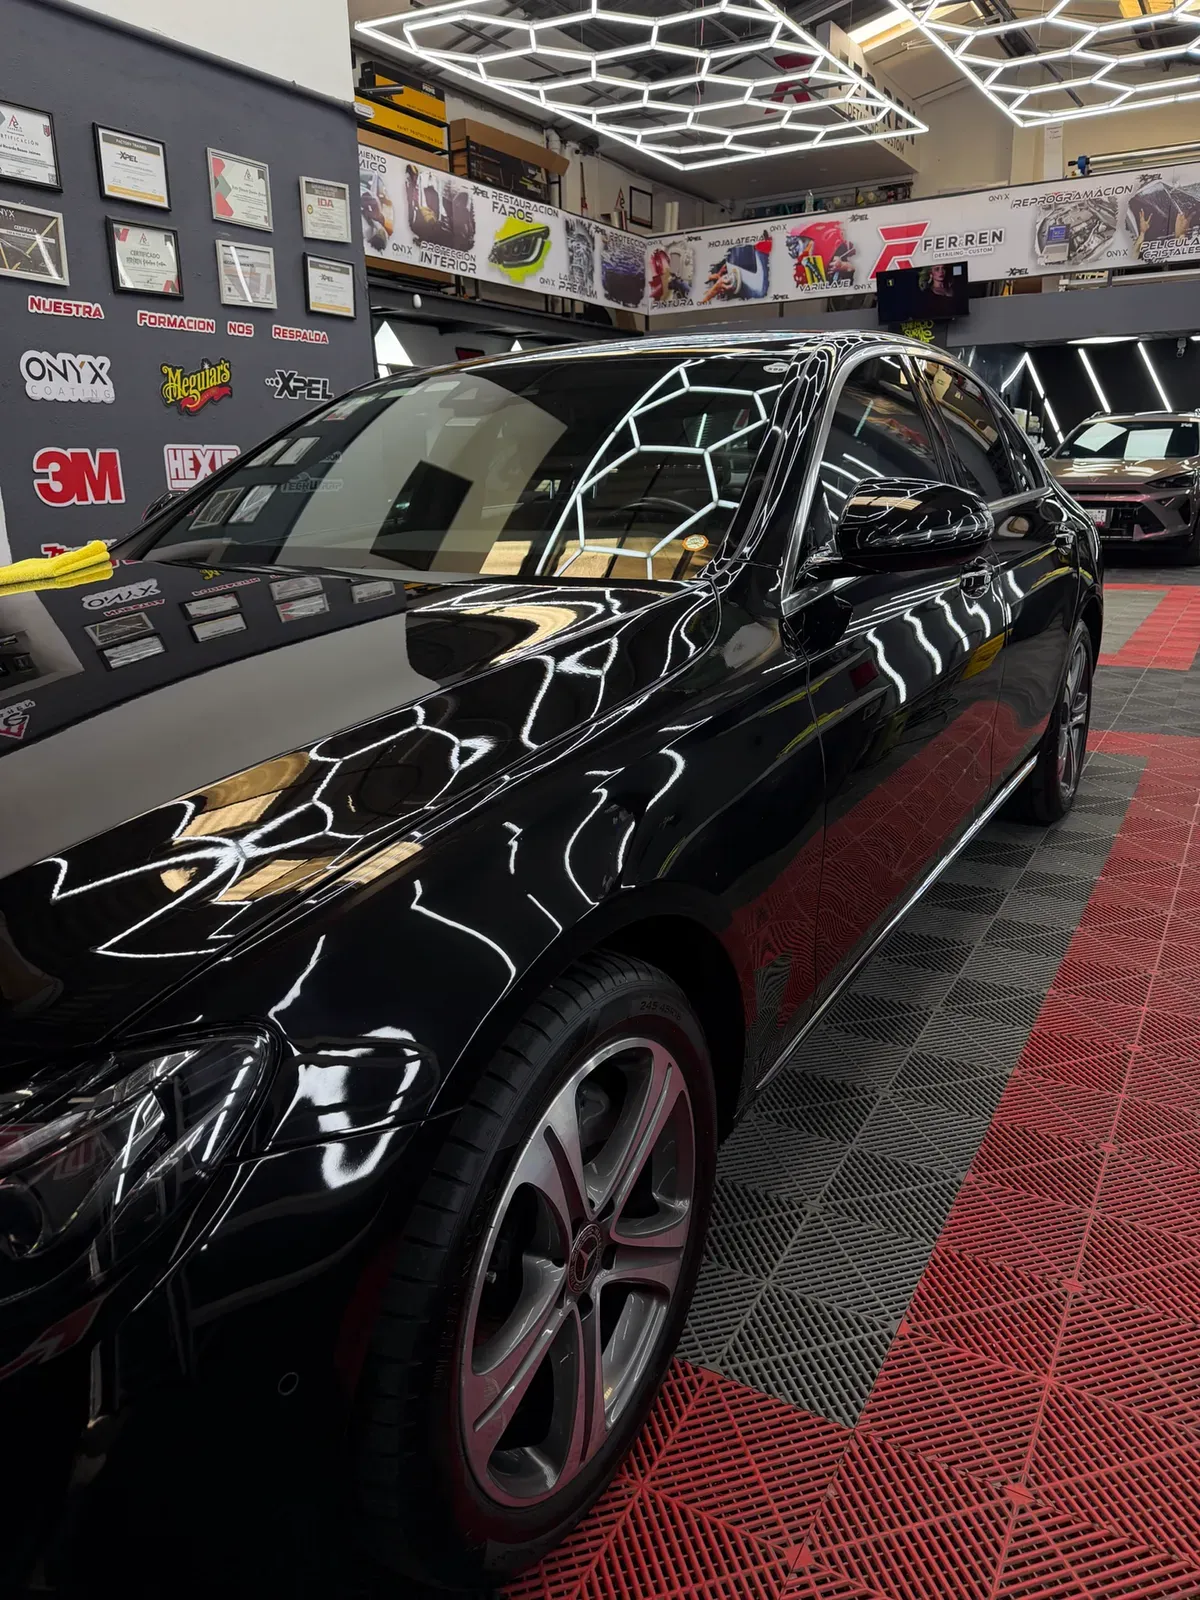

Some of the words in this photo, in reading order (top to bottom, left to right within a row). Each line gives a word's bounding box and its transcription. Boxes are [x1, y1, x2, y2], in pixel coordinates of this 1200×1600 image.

[117, 151, 138, 163] XPEL
[1138, 174, 1162, 183] XPEL
[472, 185, 489, 199] XPEL
[1012, 185, 1133, 209] REPROGRAMACION
[317, 198, 334, 209] IDA
[491, 191, 559, 218] RESTAURACION
[492, 201, 533, 223] FAROS
[849, 214, 869, 222] XPEL
[708, 235, 764, 248] HOJALATERIA
[1141, 238, 1200, 251] PELICULA
[421, 241, 476, 262] PROTECCION
[934, 250, 964, 258] DETAILING
[968, 247, 993, 255] CUSTOM
[1143, 246, 1200, 259] CRISTALES
[420, 252, 477, 274] INTERIOR
[1006, 268, 1029, 277] XPEL
[799, 280, 850, 292] VARILLAJE
[29, 296, 103, 319] NUESTRA
[651, 299, 694, 309] PINTURA
[138, 312, 215, 332] FORMACION
[228, 322, 253, 336] NOS
[273, 326, 328, 343] RESPALDA
[26, 357, 107, 385] ONYX
[161, 359, 231, 404] Meguiar's
[271, 369, 334, 401] XPEL
[31, 385, 111, 399] COATING
[36, 451, 123, 503] 3M
